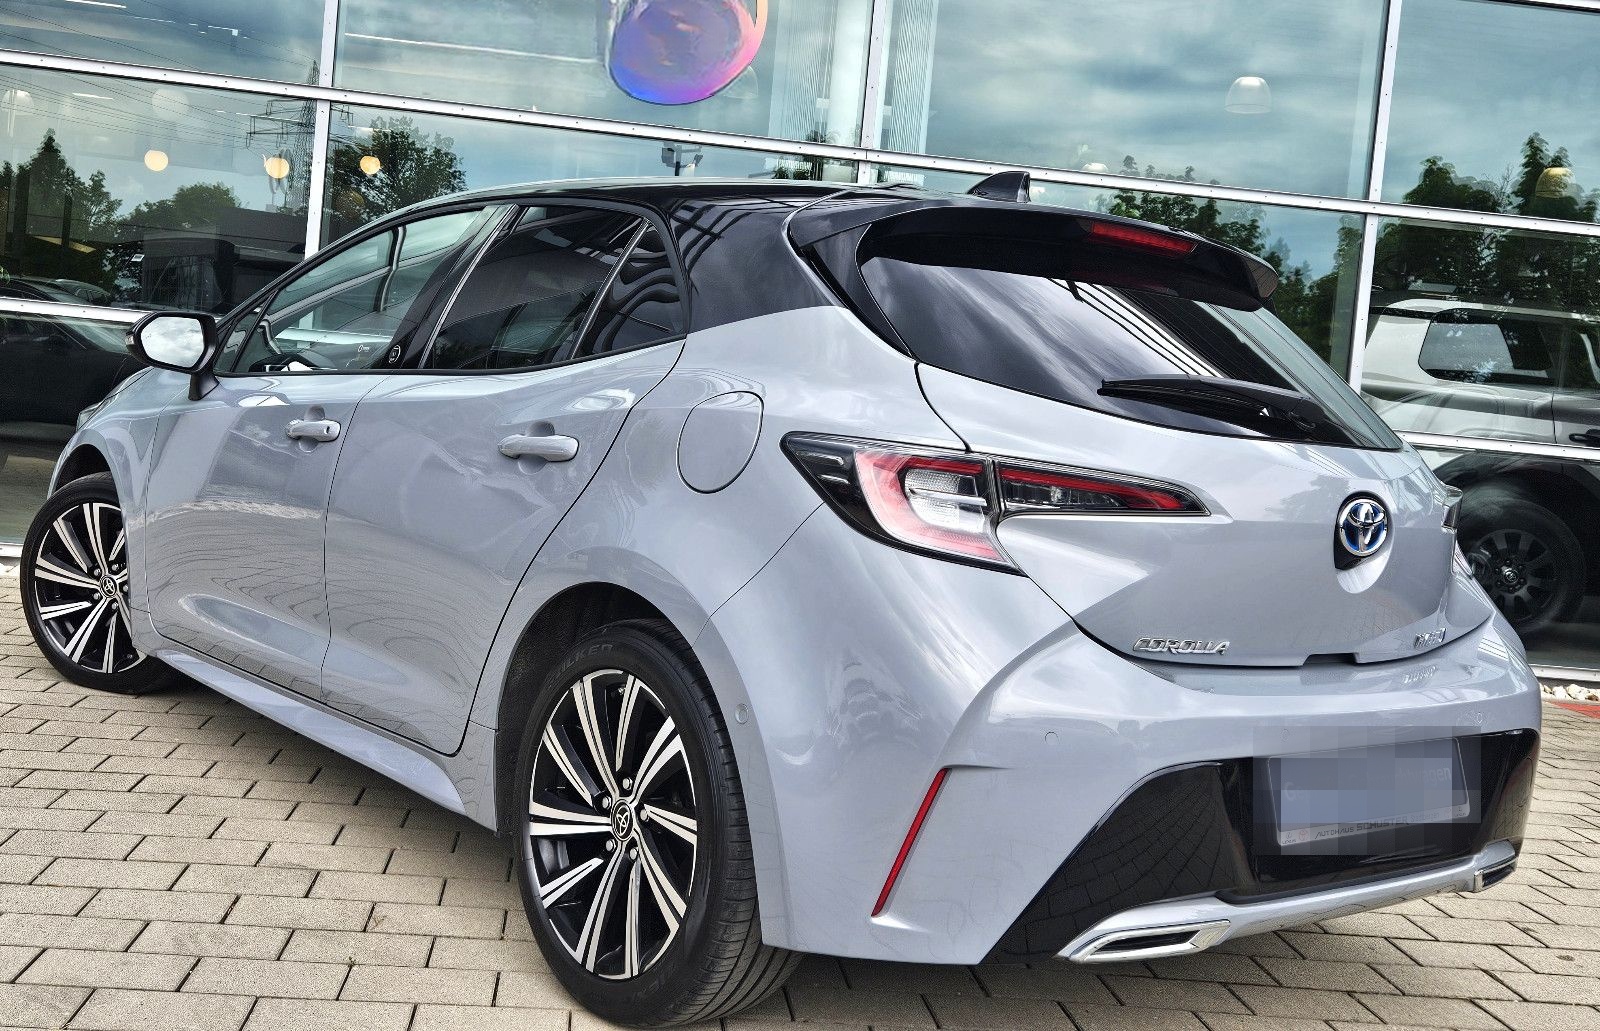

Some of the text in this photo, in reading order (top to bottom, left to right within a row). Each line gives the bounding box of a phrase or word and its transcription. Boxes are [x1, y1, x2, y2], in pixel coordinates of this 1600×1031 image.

[1133, 637, 1230, 655] COROLLA
[1315, 825, 1354, 840] AUTOHAUS
[1356, 815, 1410, 832] SCHUSTER
